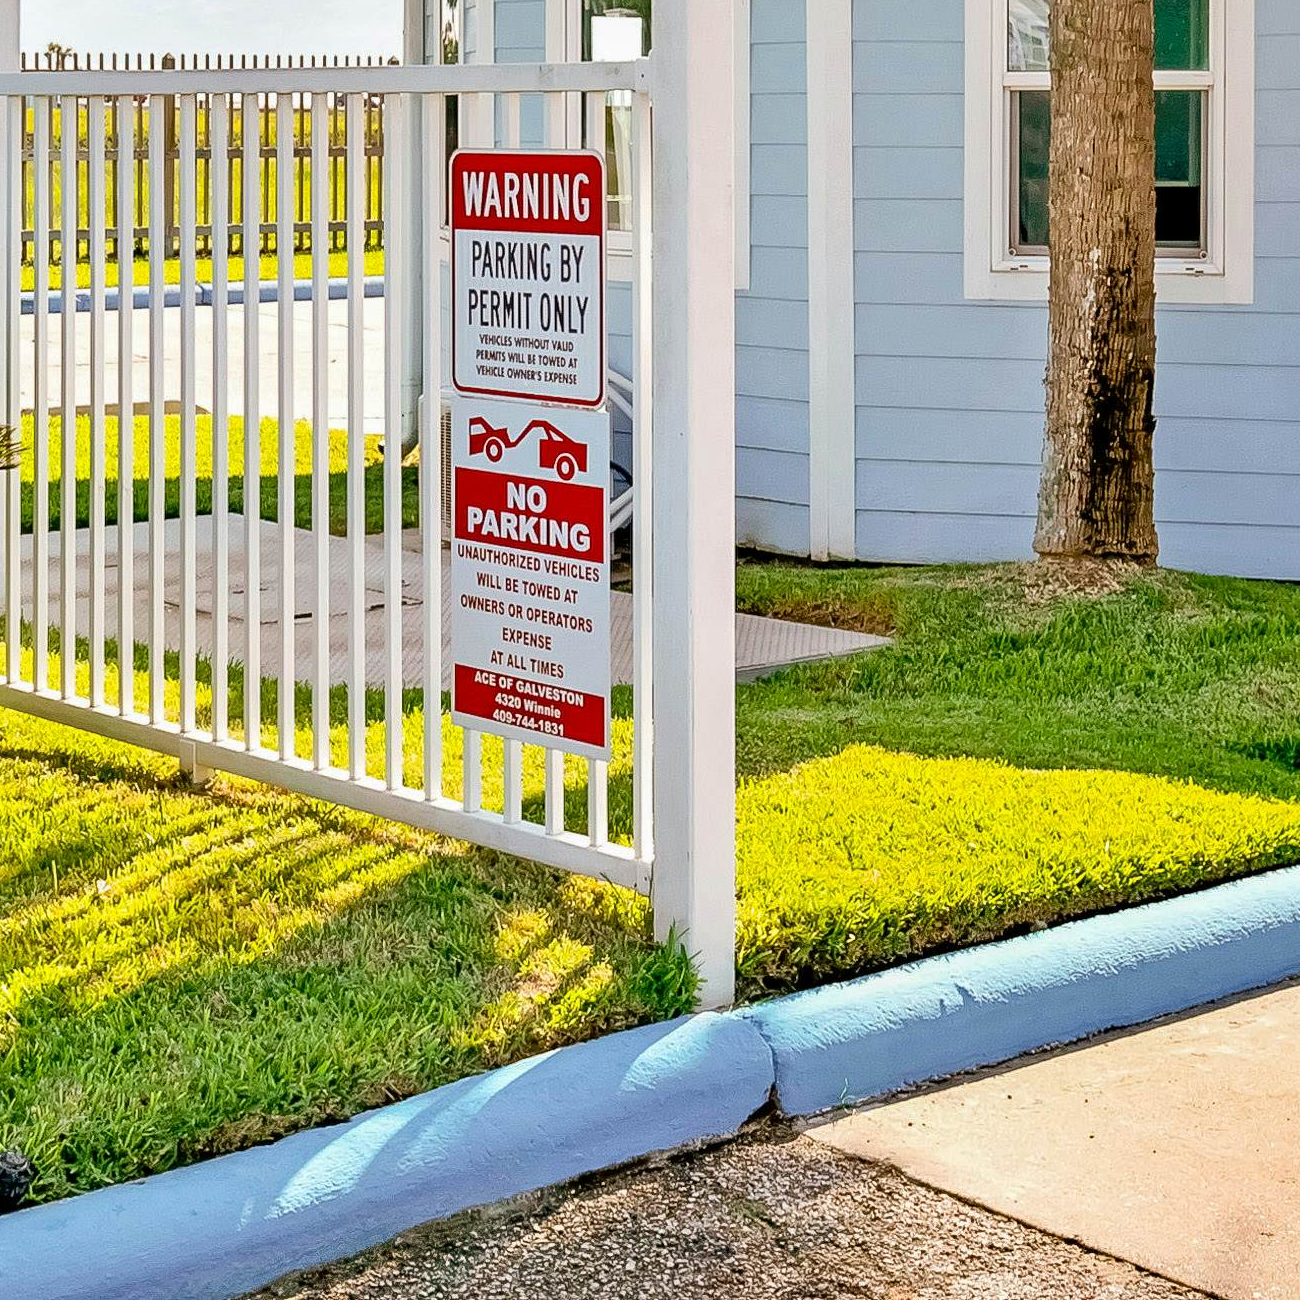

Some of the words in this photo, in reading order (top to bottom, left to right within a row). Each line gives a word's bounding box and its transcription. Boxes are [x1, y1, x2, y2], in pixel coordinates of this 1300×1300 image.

[462, 171, 590, 222] WARNING
[472, 240, 551, 283] PARKING
[560, 244, 584, 284] BY
[468, 289, 532, 328] PERMIT
[540, 293, 588, 335] ONLY
[476, 349, 506, 362] PERMITS
[508, 352, 525, 364] WILL
[528, 354, 536, 365] BE
[539, 355, 566, 368] TOWED
[568, 358, 578, 369] AT
[479, 334, 512, 347] VEHICLES
[514, 337, 549, 350] WITHOUT
[552, 340, 574, 352] VALID
[476, 365, 505, 377] VEHICLE
[507, 368, 542, 381] OWNER'S
[544, 371, 577, 385] EXPENSE
[506, 481, 548, 514] NO
[467, 506, 591, 552] PARKING
[457, 544, 541, 572] UNAUTHORIZED
[544, 559, 600, 583] VEHICLES
[476, 572, 501, 590] WILL
[505, 578, 519, 593] BE
[522, 580, 560, 601] TOWED
[563, 589, 578, 605] AT
[460, 594, 505, 615] OWNERS
[508, 603, 523, 620] OR
[526, 607, 593, 633] OPERATORS
[502, 627, 552, 651] EXPENSE
[490, 650, 504, 665] AT
[507, 654, 527, 671] ALL
[529, 658, 564, 679] TIMES
[474, 671, 497, 687] ACE
[499, 676, 513, 690] OF
[516, 681, 584, 707] GALVESTON
[495, 692, 522, 709] 4320
[523, 698, 561, 719] Winnie
[492, 708, 565, 737] 409-744-1831
